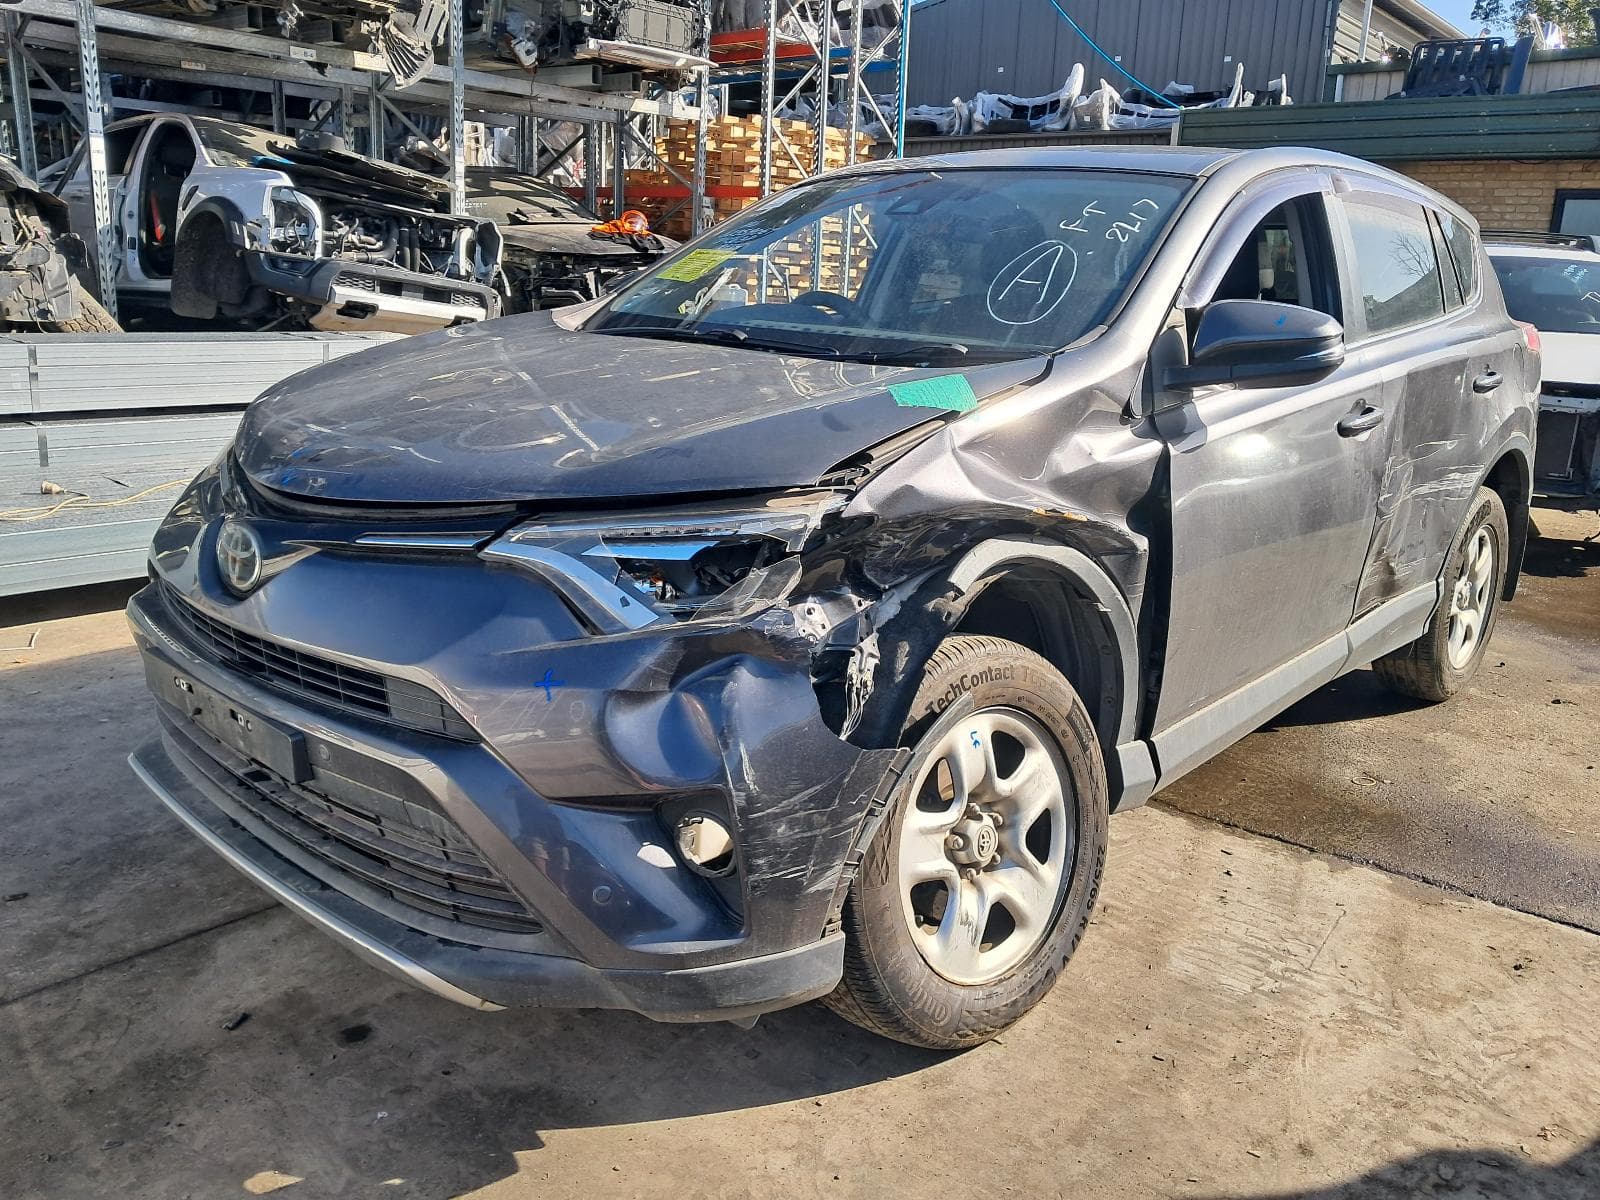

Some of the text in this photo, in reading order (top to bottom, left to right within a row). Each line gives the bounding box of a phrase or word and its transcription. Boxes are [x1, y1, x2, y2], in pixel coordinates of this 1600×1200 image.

[998, 244, 1064, 304] A
[925, 665, 1016, 714] TechContact
[1087, 844, 1105, 911] 225/65
